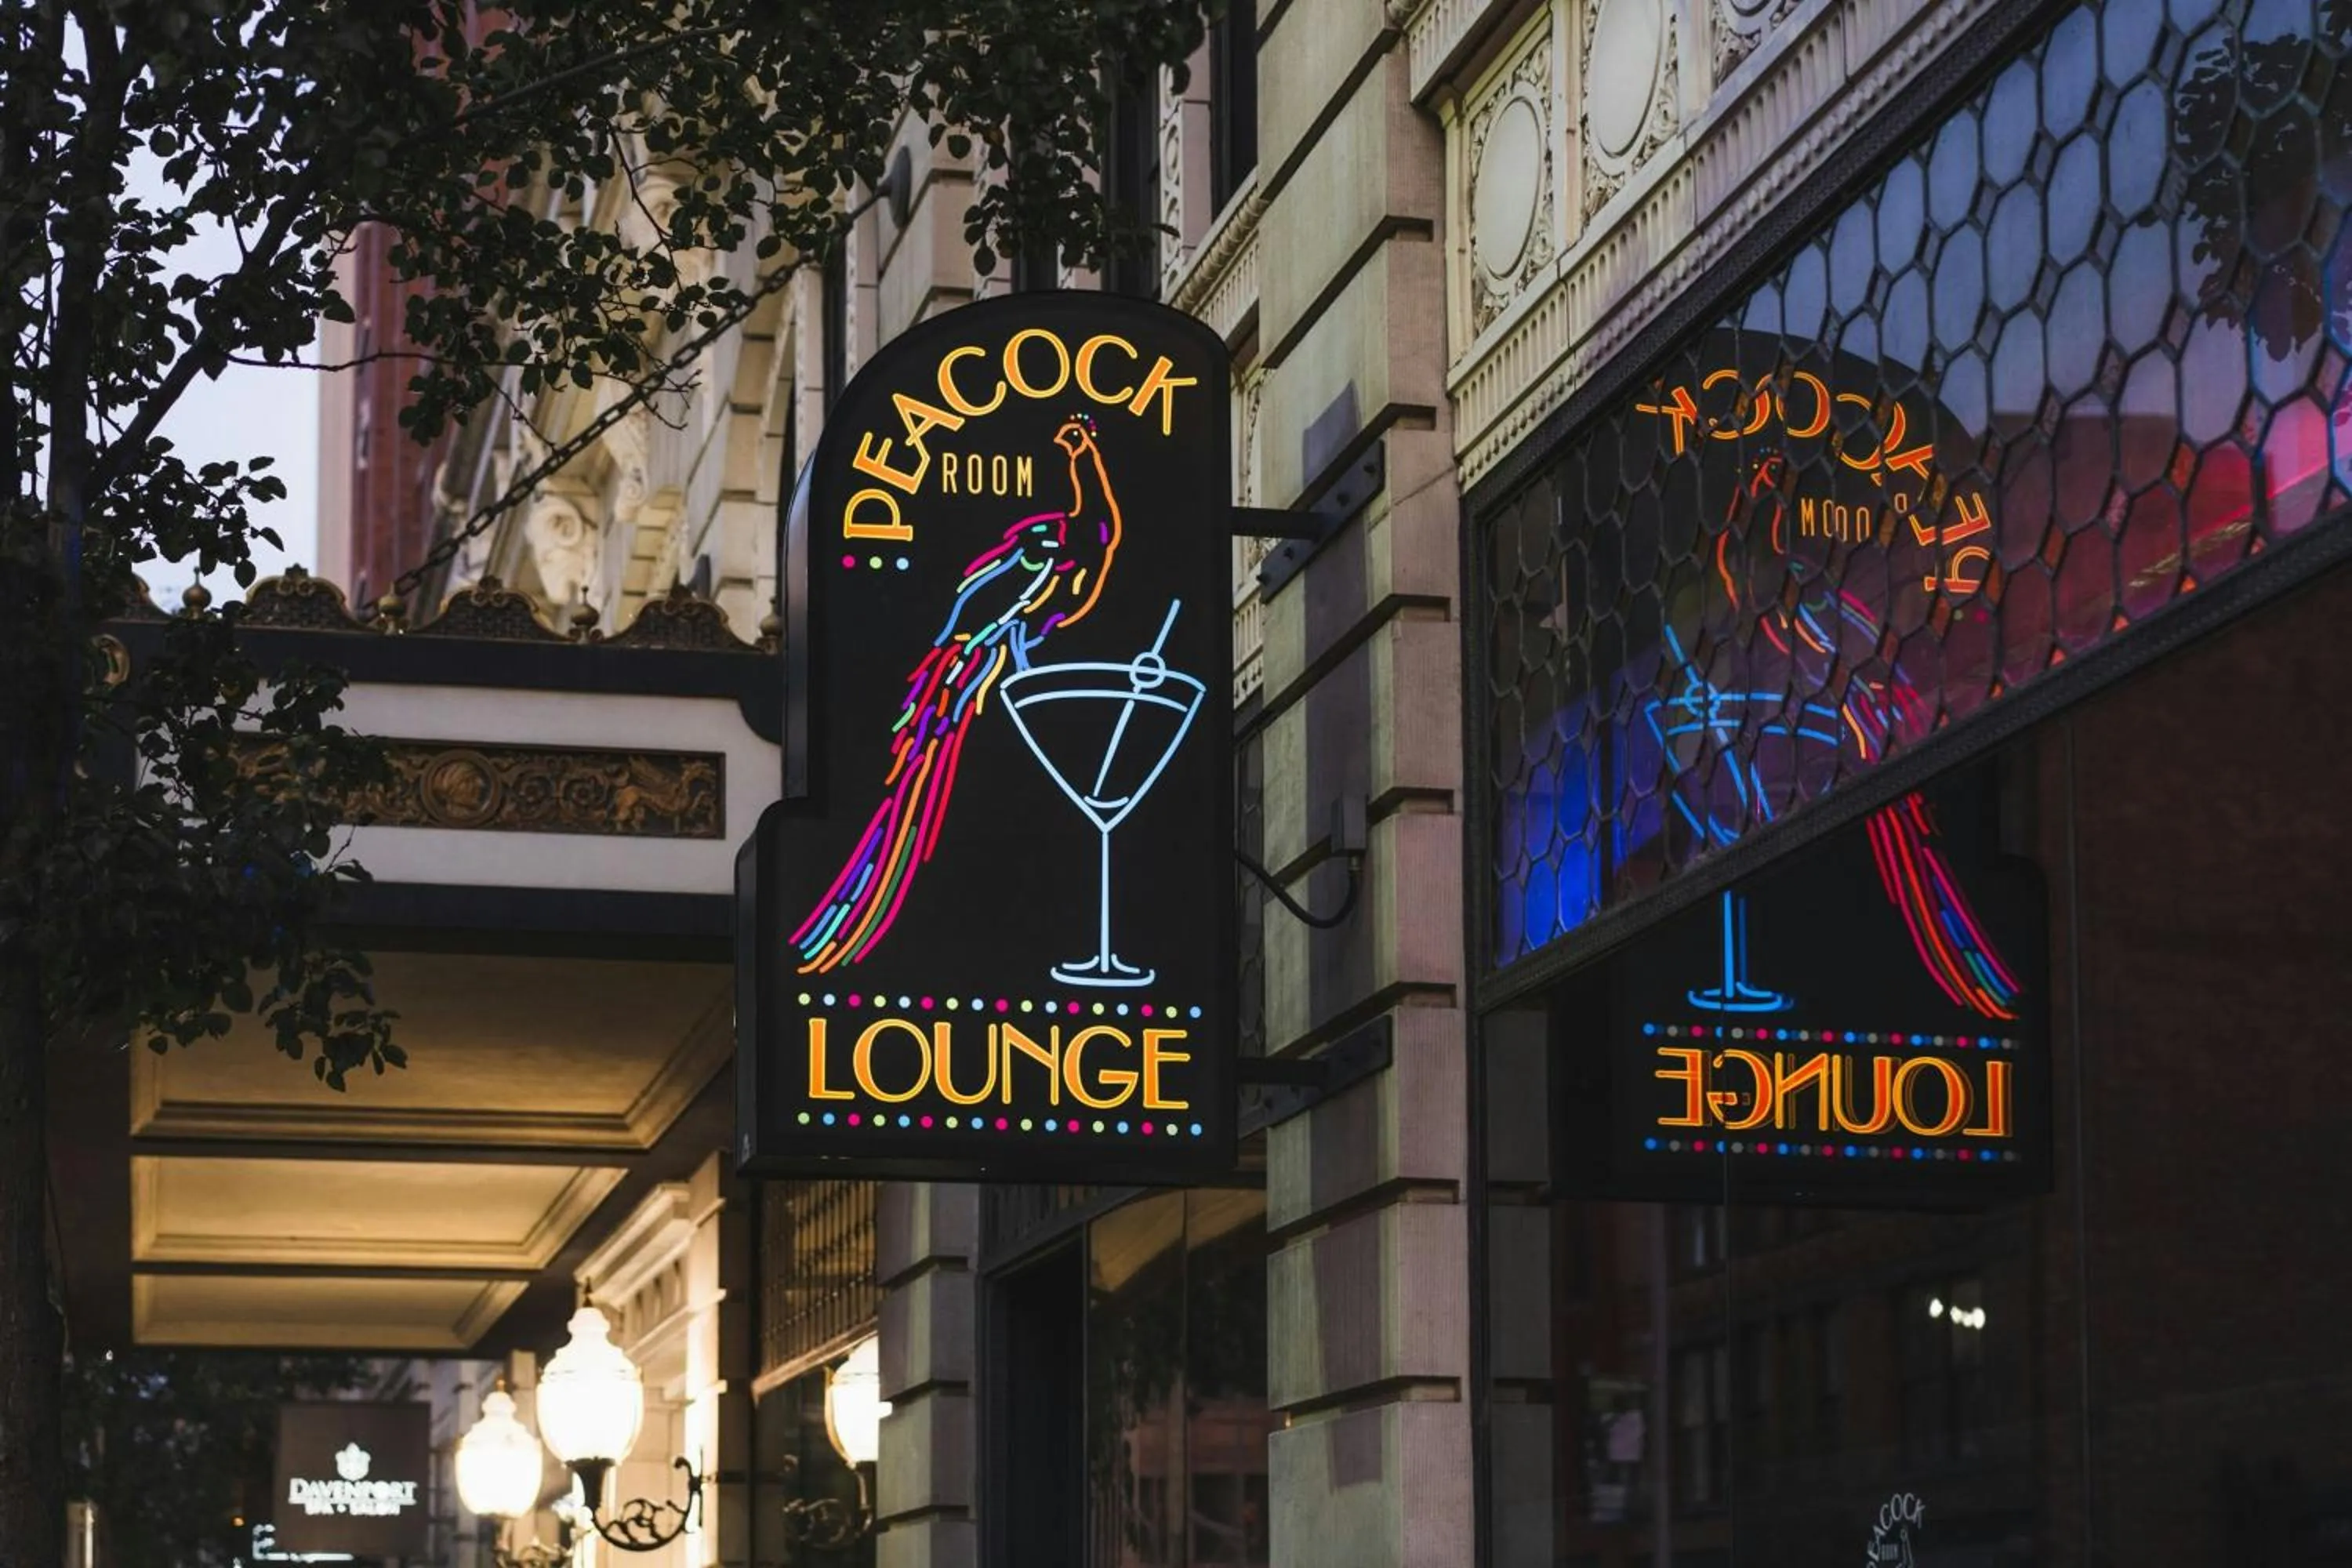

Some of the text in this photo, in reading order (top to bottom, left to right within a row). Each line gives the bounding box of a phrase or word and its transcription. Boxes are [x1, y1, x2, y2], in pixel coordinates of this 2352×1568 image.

[844, 328, 1197, 541] PEACOCK
[942, 452, 1033, 497] ROOM
[809, 1018, 1190, 1109] LOUNGE
